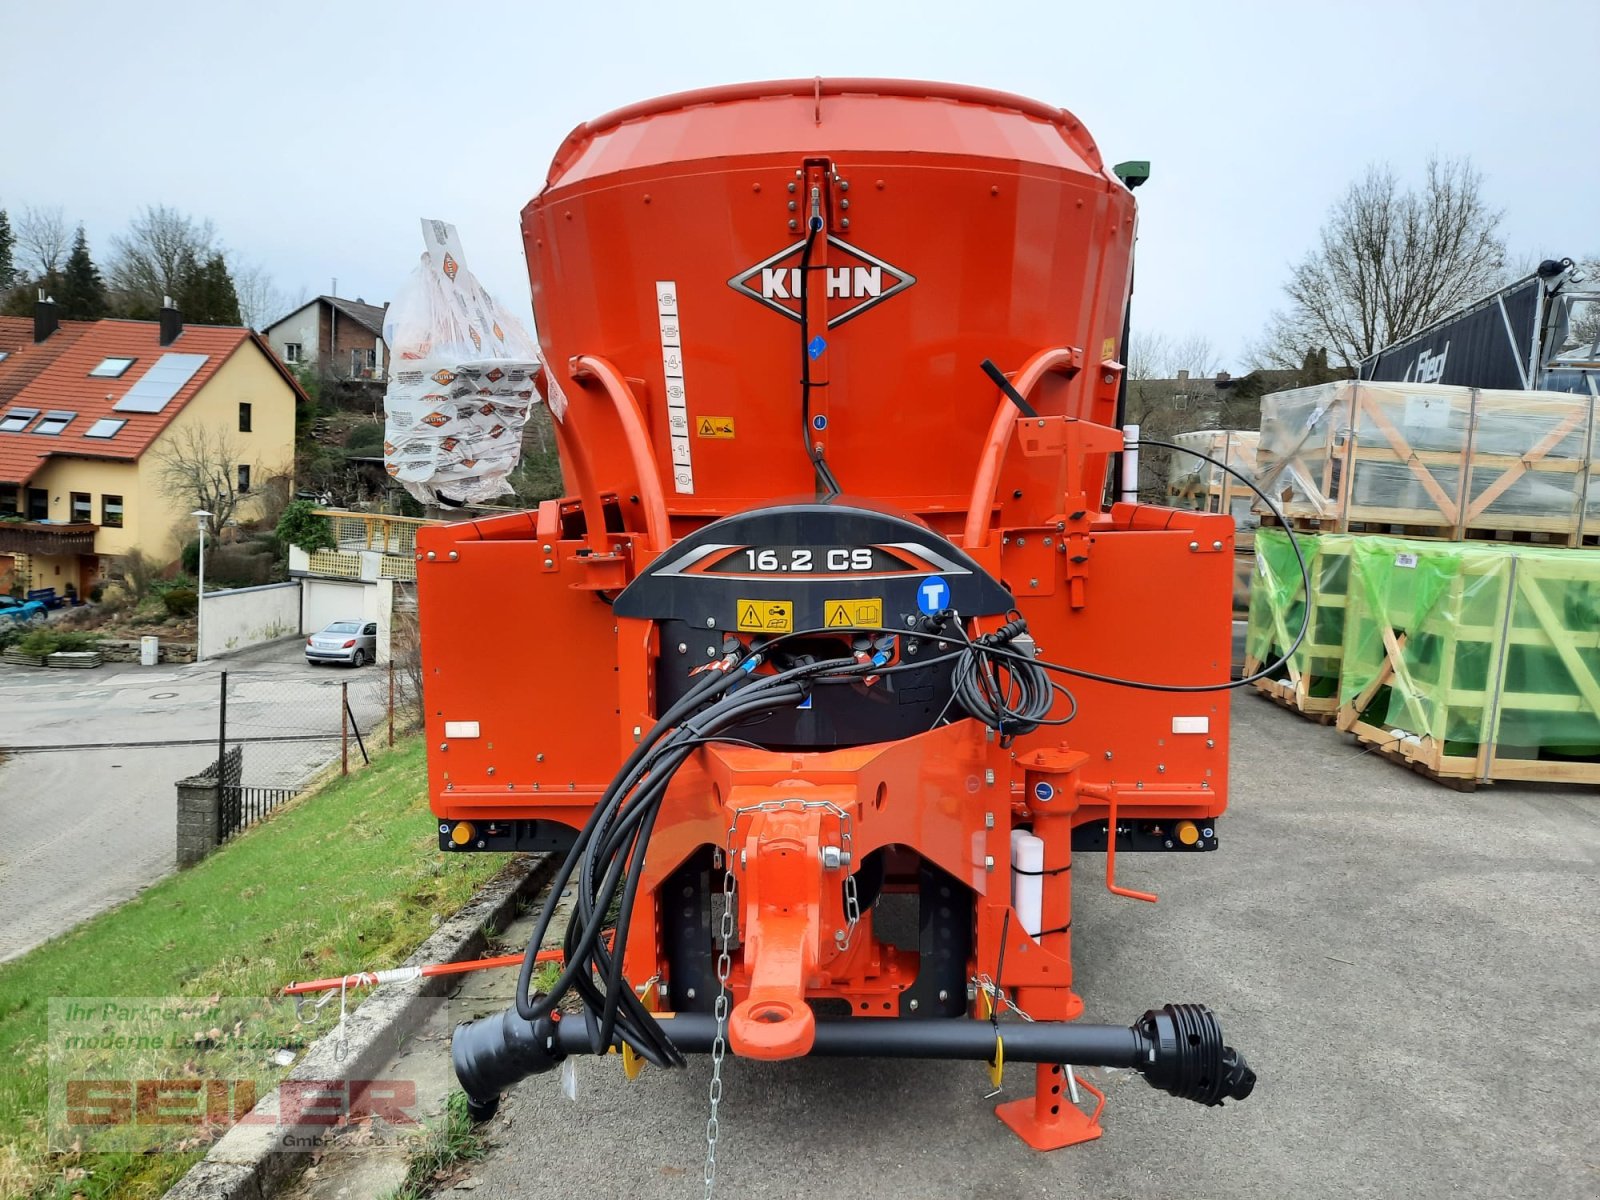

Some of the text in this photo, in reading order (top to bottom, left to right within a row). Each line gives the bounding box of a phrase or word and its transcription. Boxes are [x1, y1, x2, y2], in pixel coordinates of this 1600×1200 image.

[661, 293, 674, 306] 6
[664, 324, 677, 337] 5
[667, 354, 679, 369] 4
[669, 385, 682, 398] 3
[672, 415, 685, 428] 2
[677, 445, 686, 457] 1
[677, 473, 690, 485] 0
[746, 549, 873, 571] 16.2 CS
[922, 584, 944, 610] T
